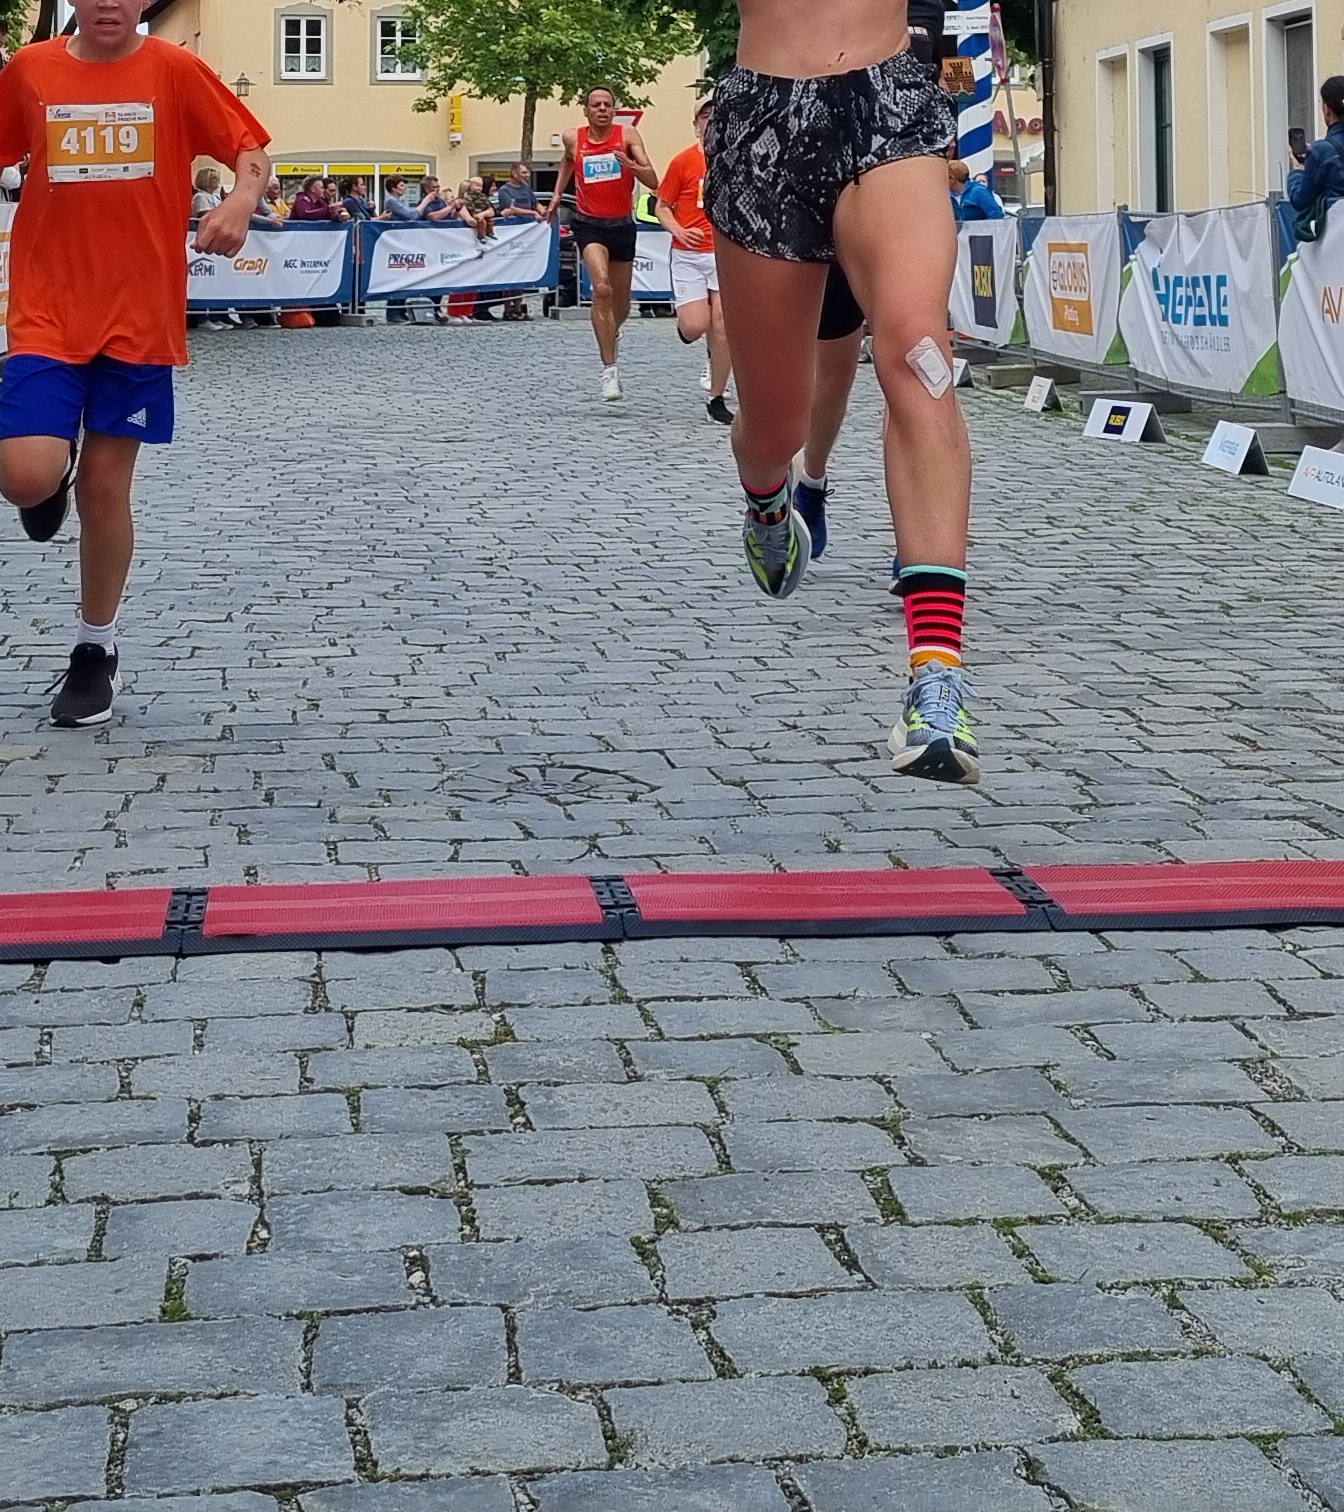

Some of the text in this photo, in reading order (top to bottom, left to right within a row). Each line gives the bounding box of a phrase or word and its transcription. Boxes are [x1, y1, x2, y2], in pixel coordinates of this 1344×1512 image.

[60, 125, 138, 154] 4119
[588, 161, 614, 174] 7037
[388, 253, 426, 265] PREGLER
[188, 261, 215, 276] KERMI
